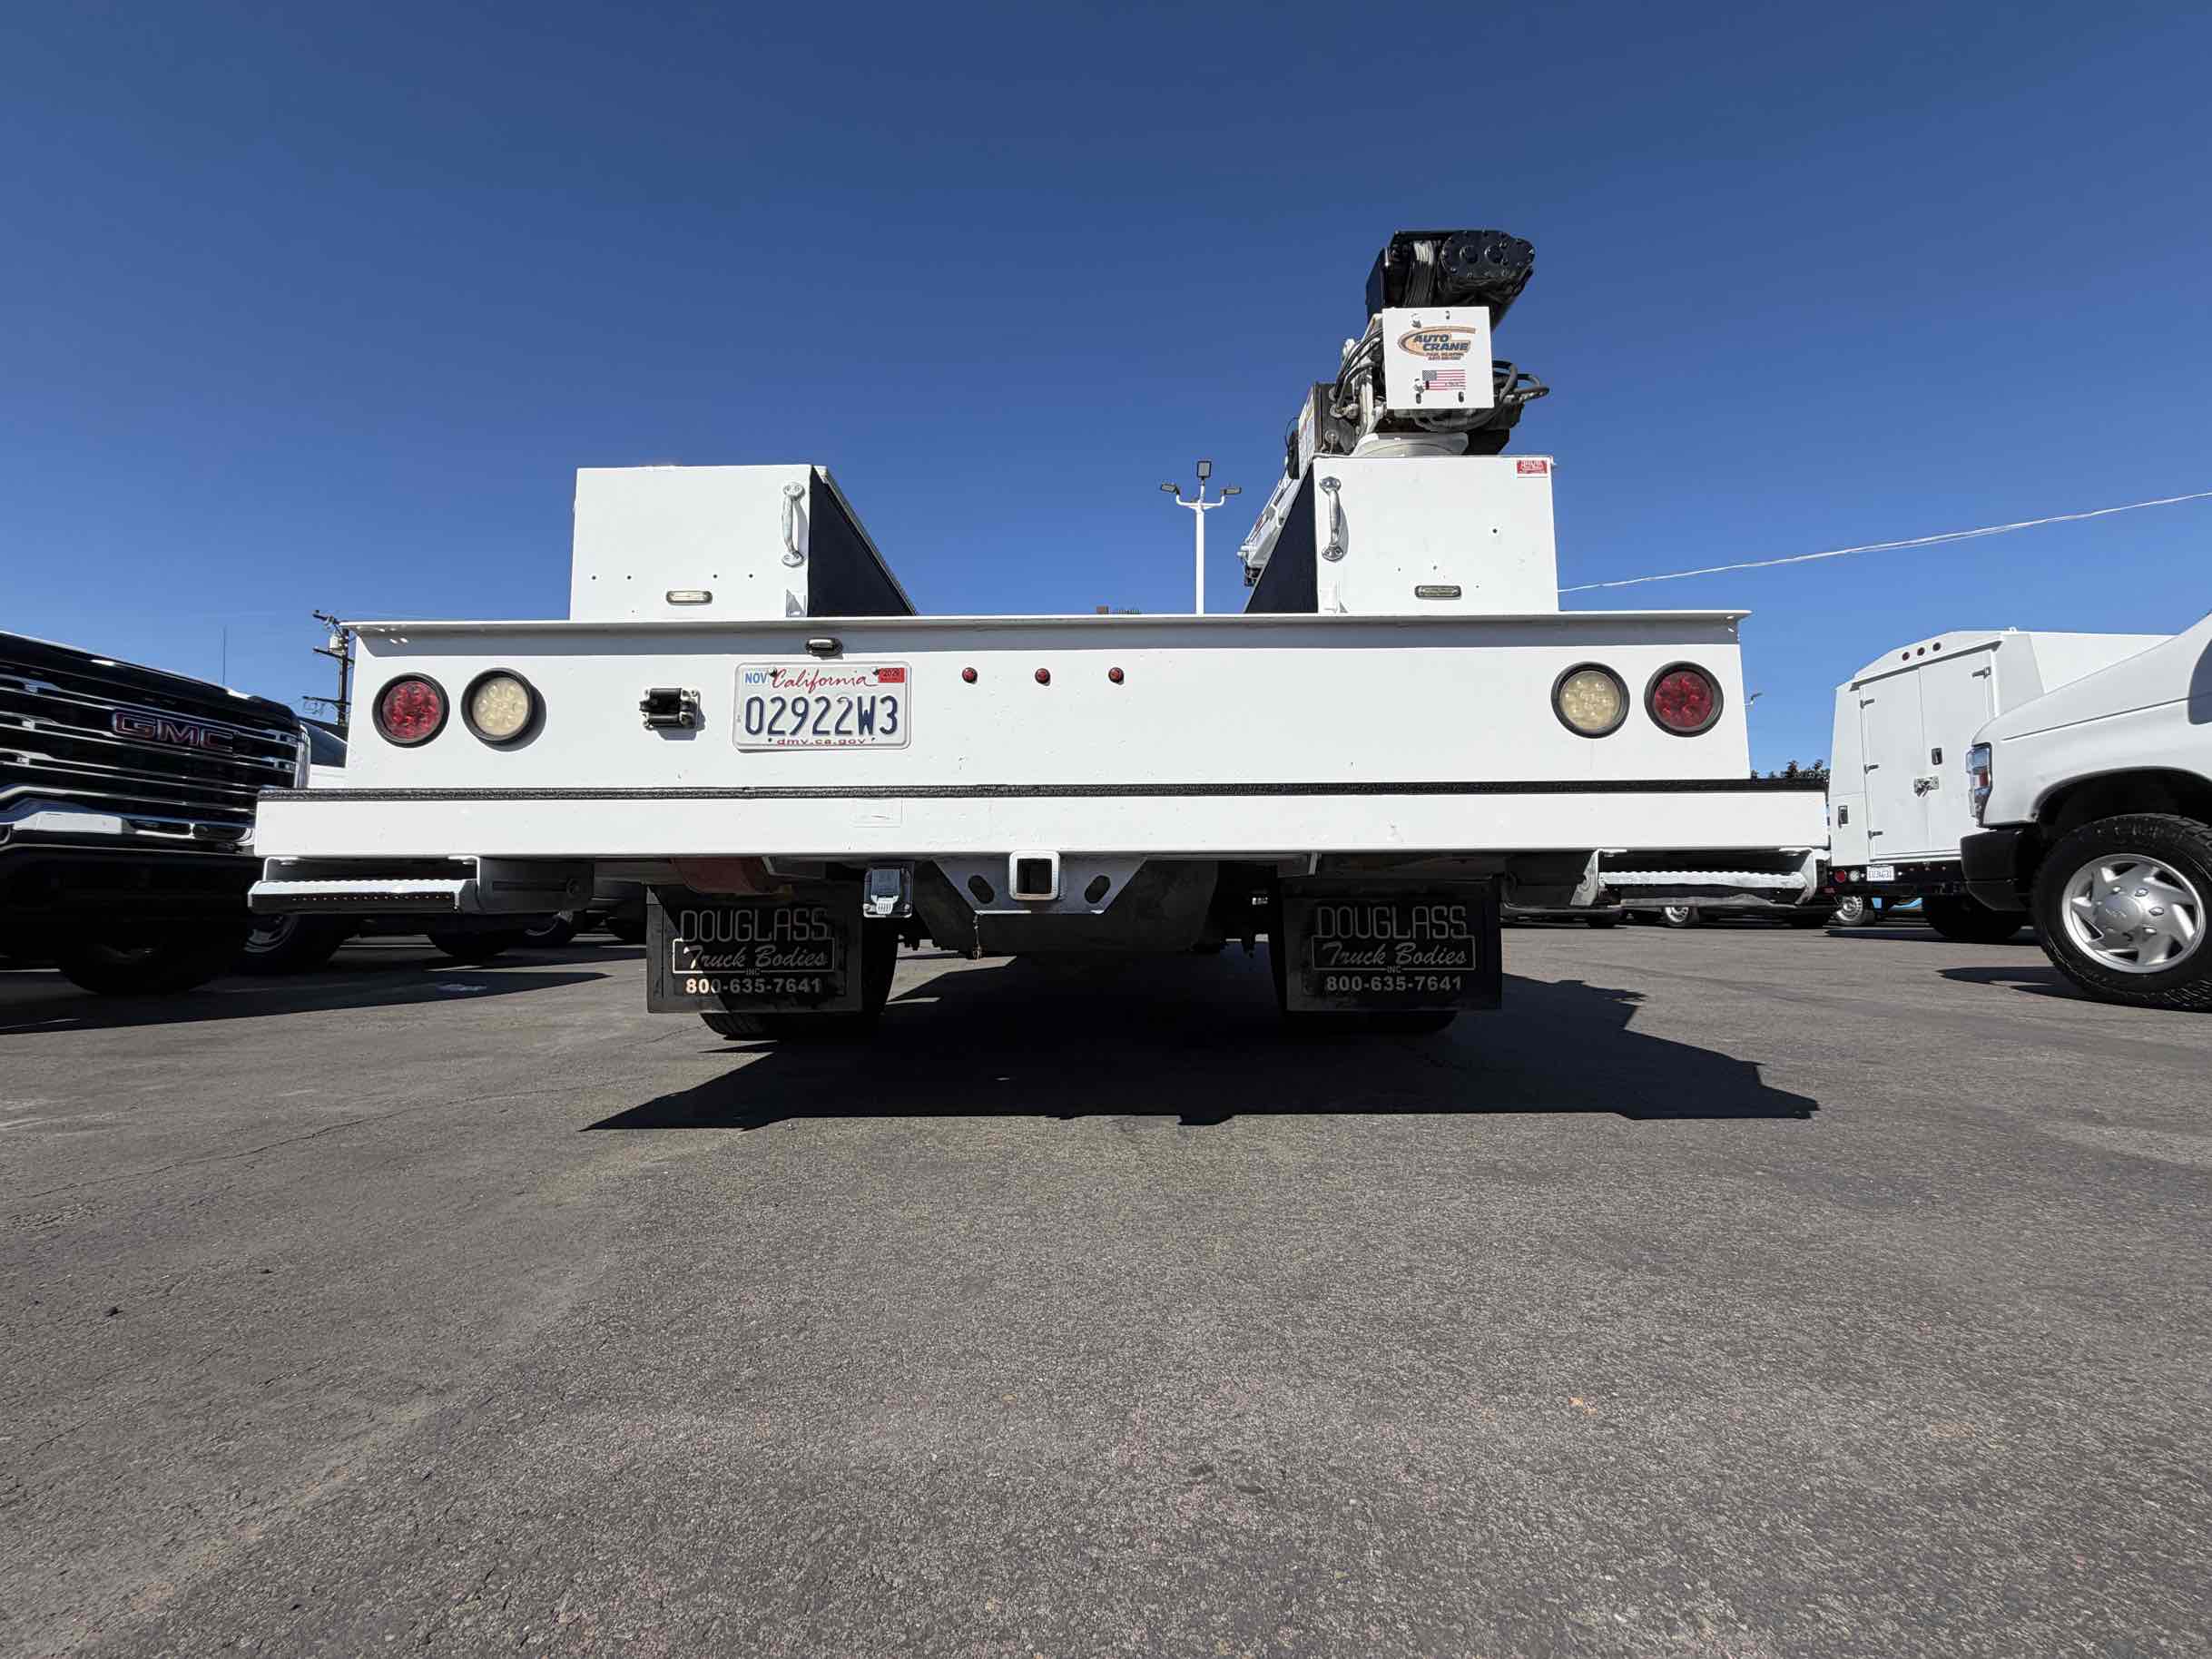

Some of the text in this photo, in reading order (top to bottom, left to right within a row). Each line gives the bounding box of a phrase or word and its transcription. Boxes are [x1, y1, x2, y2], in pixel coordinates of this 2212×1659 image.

[1414, 334, 1449, 343] AUTO
[1422, 343, 1469, 352] CRANE
[745, 672, 767, 683] NOV
[772, 668, 878, 693] California
[744, 695, 899, 736] 02922W3
[112, 710, 234, 751] GMC
[776, 738, 866, 746] dmv.ca.gov
[681, 909, 830, 942] DOUGLASS
[1317, 906, 1468, 939] DOUGLASS
[683, 944, 829, 969] Truck Bodies
[1322, 940, 1468, 967] Truck Bodies
[685, 977, 821, 995] 800-635-7641
[1326, 975, 1462, 992] 800-635-7641
